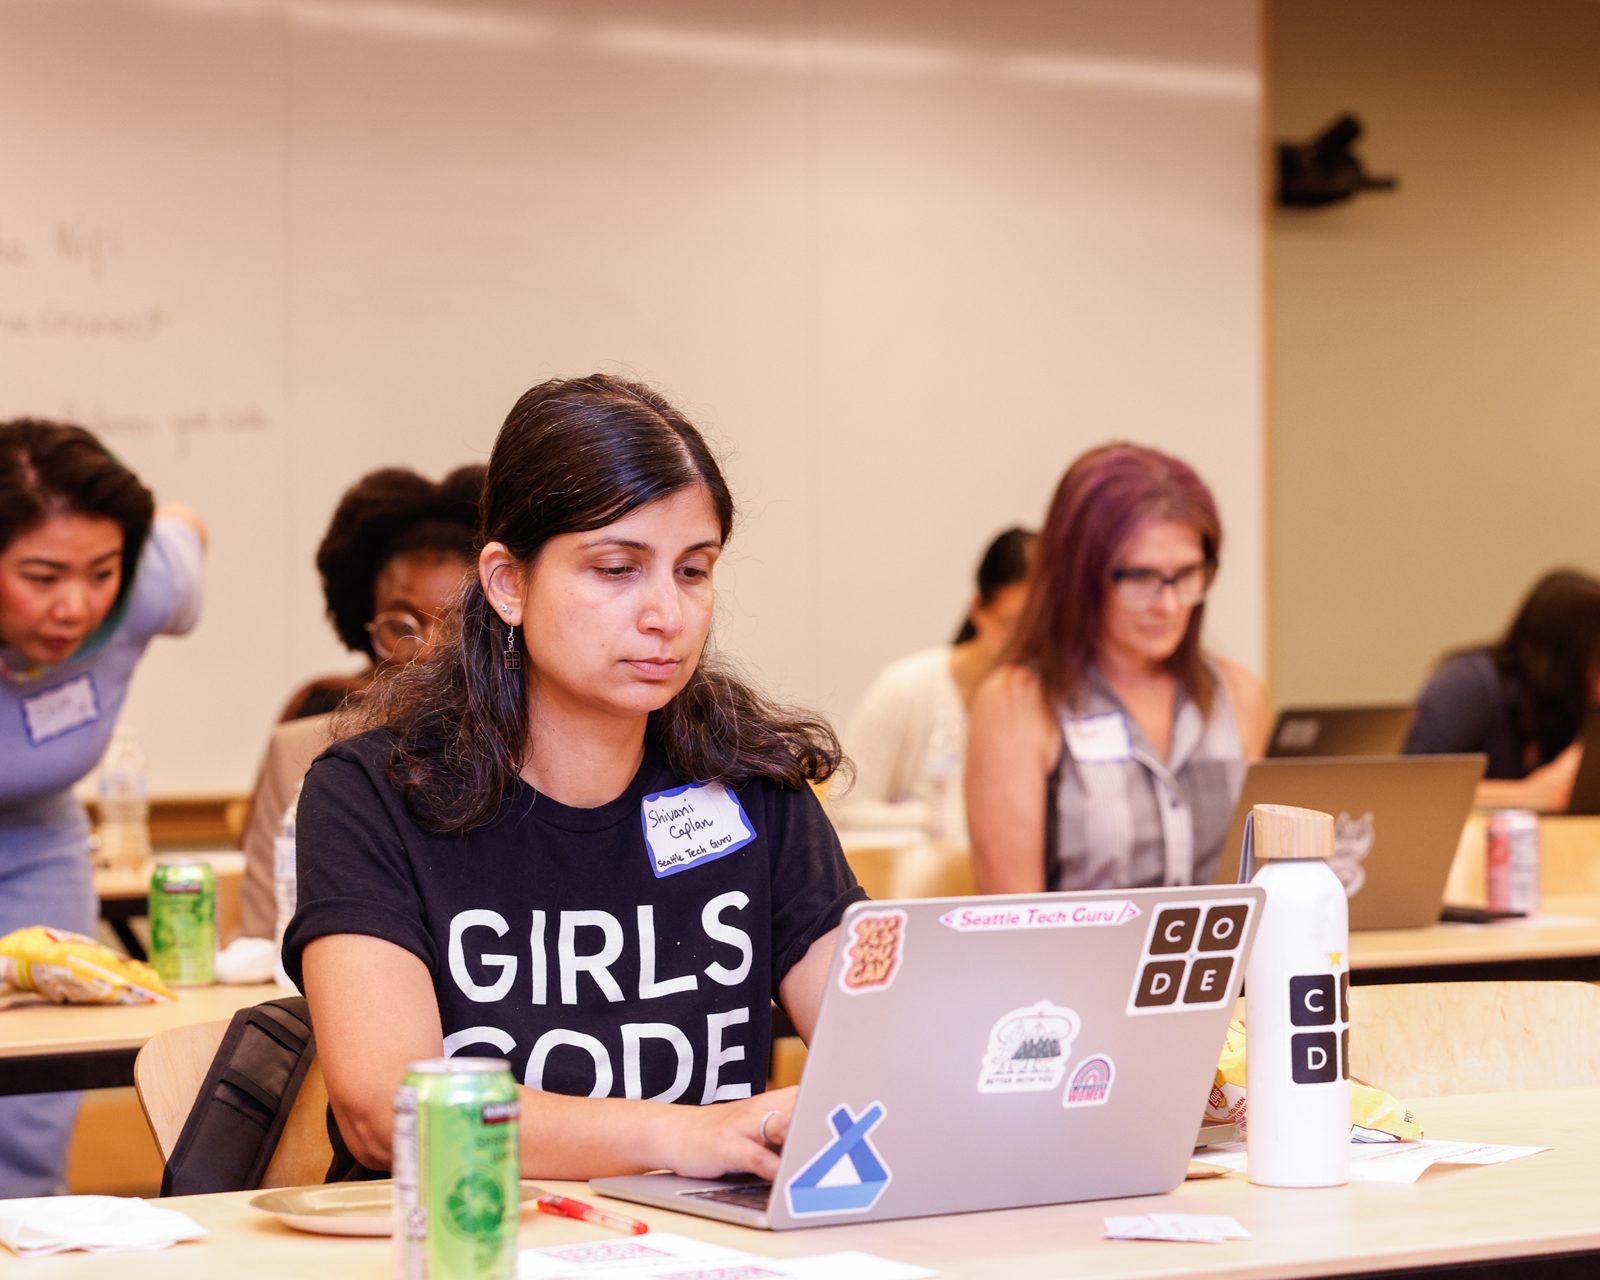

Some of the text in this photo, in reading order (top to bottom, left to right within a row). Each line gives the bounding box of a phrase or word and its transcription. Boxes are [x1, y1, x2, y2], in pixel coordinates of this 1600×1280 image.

[648, 799, 694, 828] Shivani
[669, 818, 713, 840] Caplan
[657, 834, 732, 868] Seattle Tech Guru
[960, 911, 1020, 927] Seattle
[1027, 908, 1066, 925] Tech
[1072, 907, 1113, 922] Guru
[448, 890, 753, 1005] GIRLS
